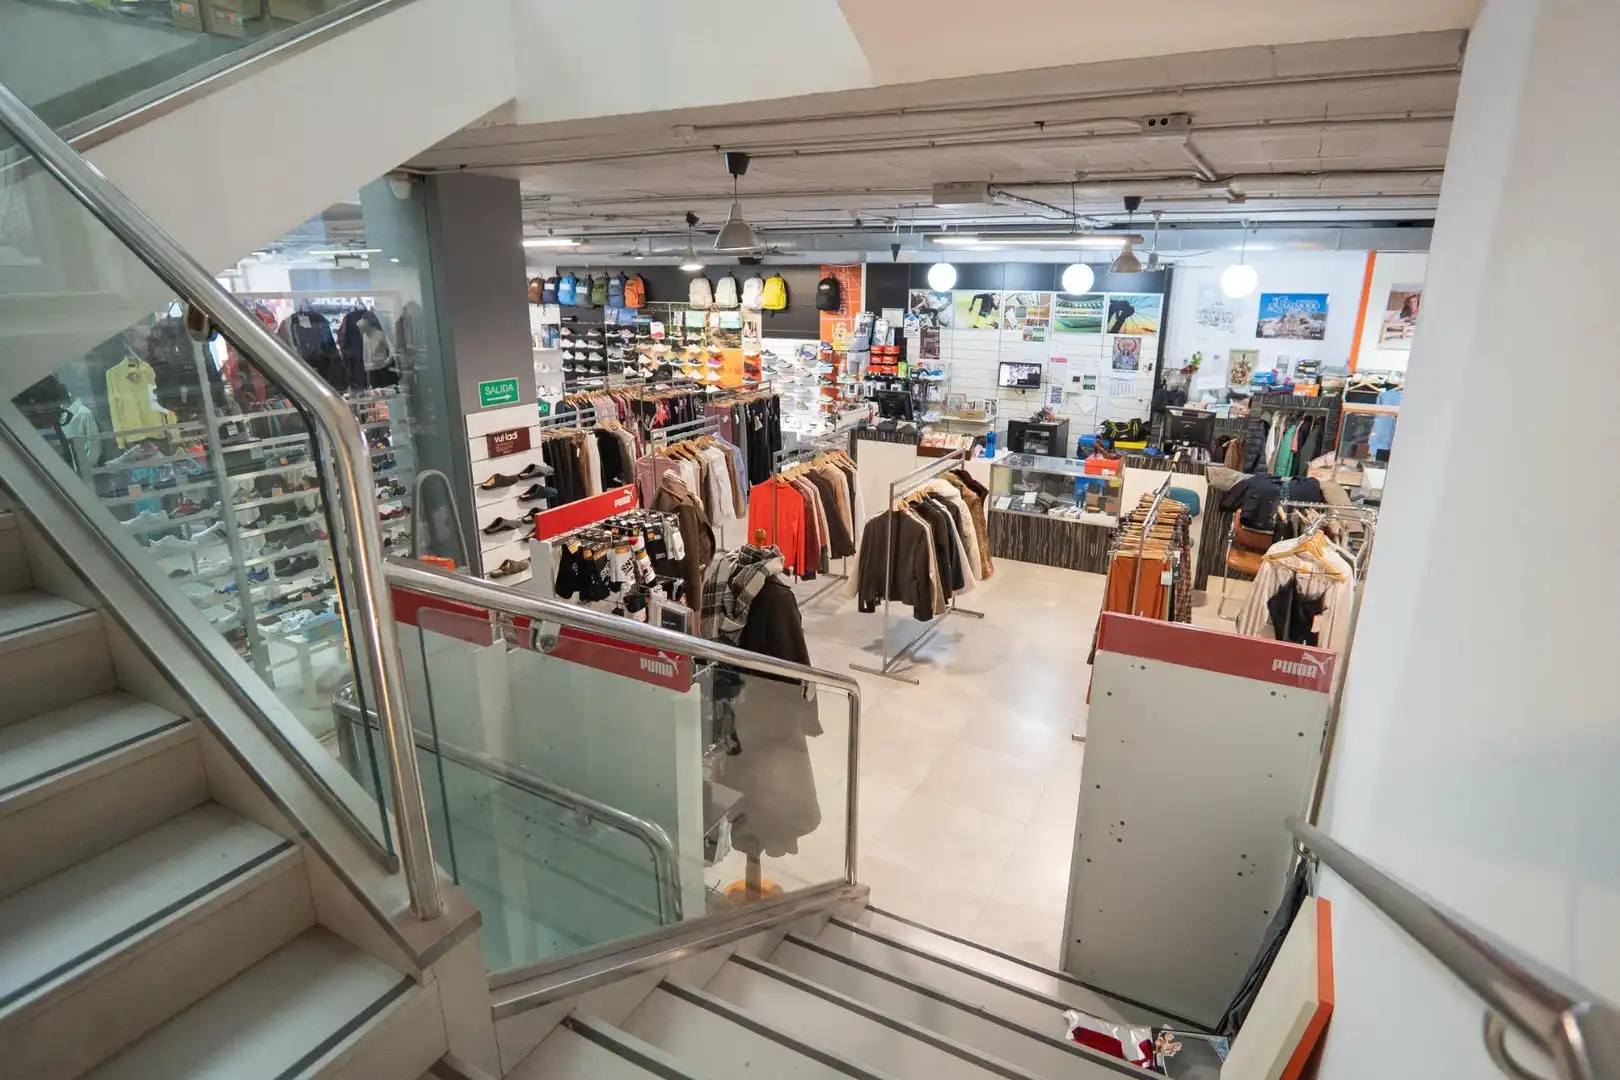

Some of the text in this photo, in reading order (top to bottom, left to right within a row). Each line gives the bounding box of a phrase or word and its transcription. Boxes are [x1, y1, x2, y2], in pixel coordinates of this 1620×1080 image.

[484, 383, 514, 395] SALIDA
[640, 657, 674, 678] PUMA
[1271, 658, 1318, 679] PUMA
